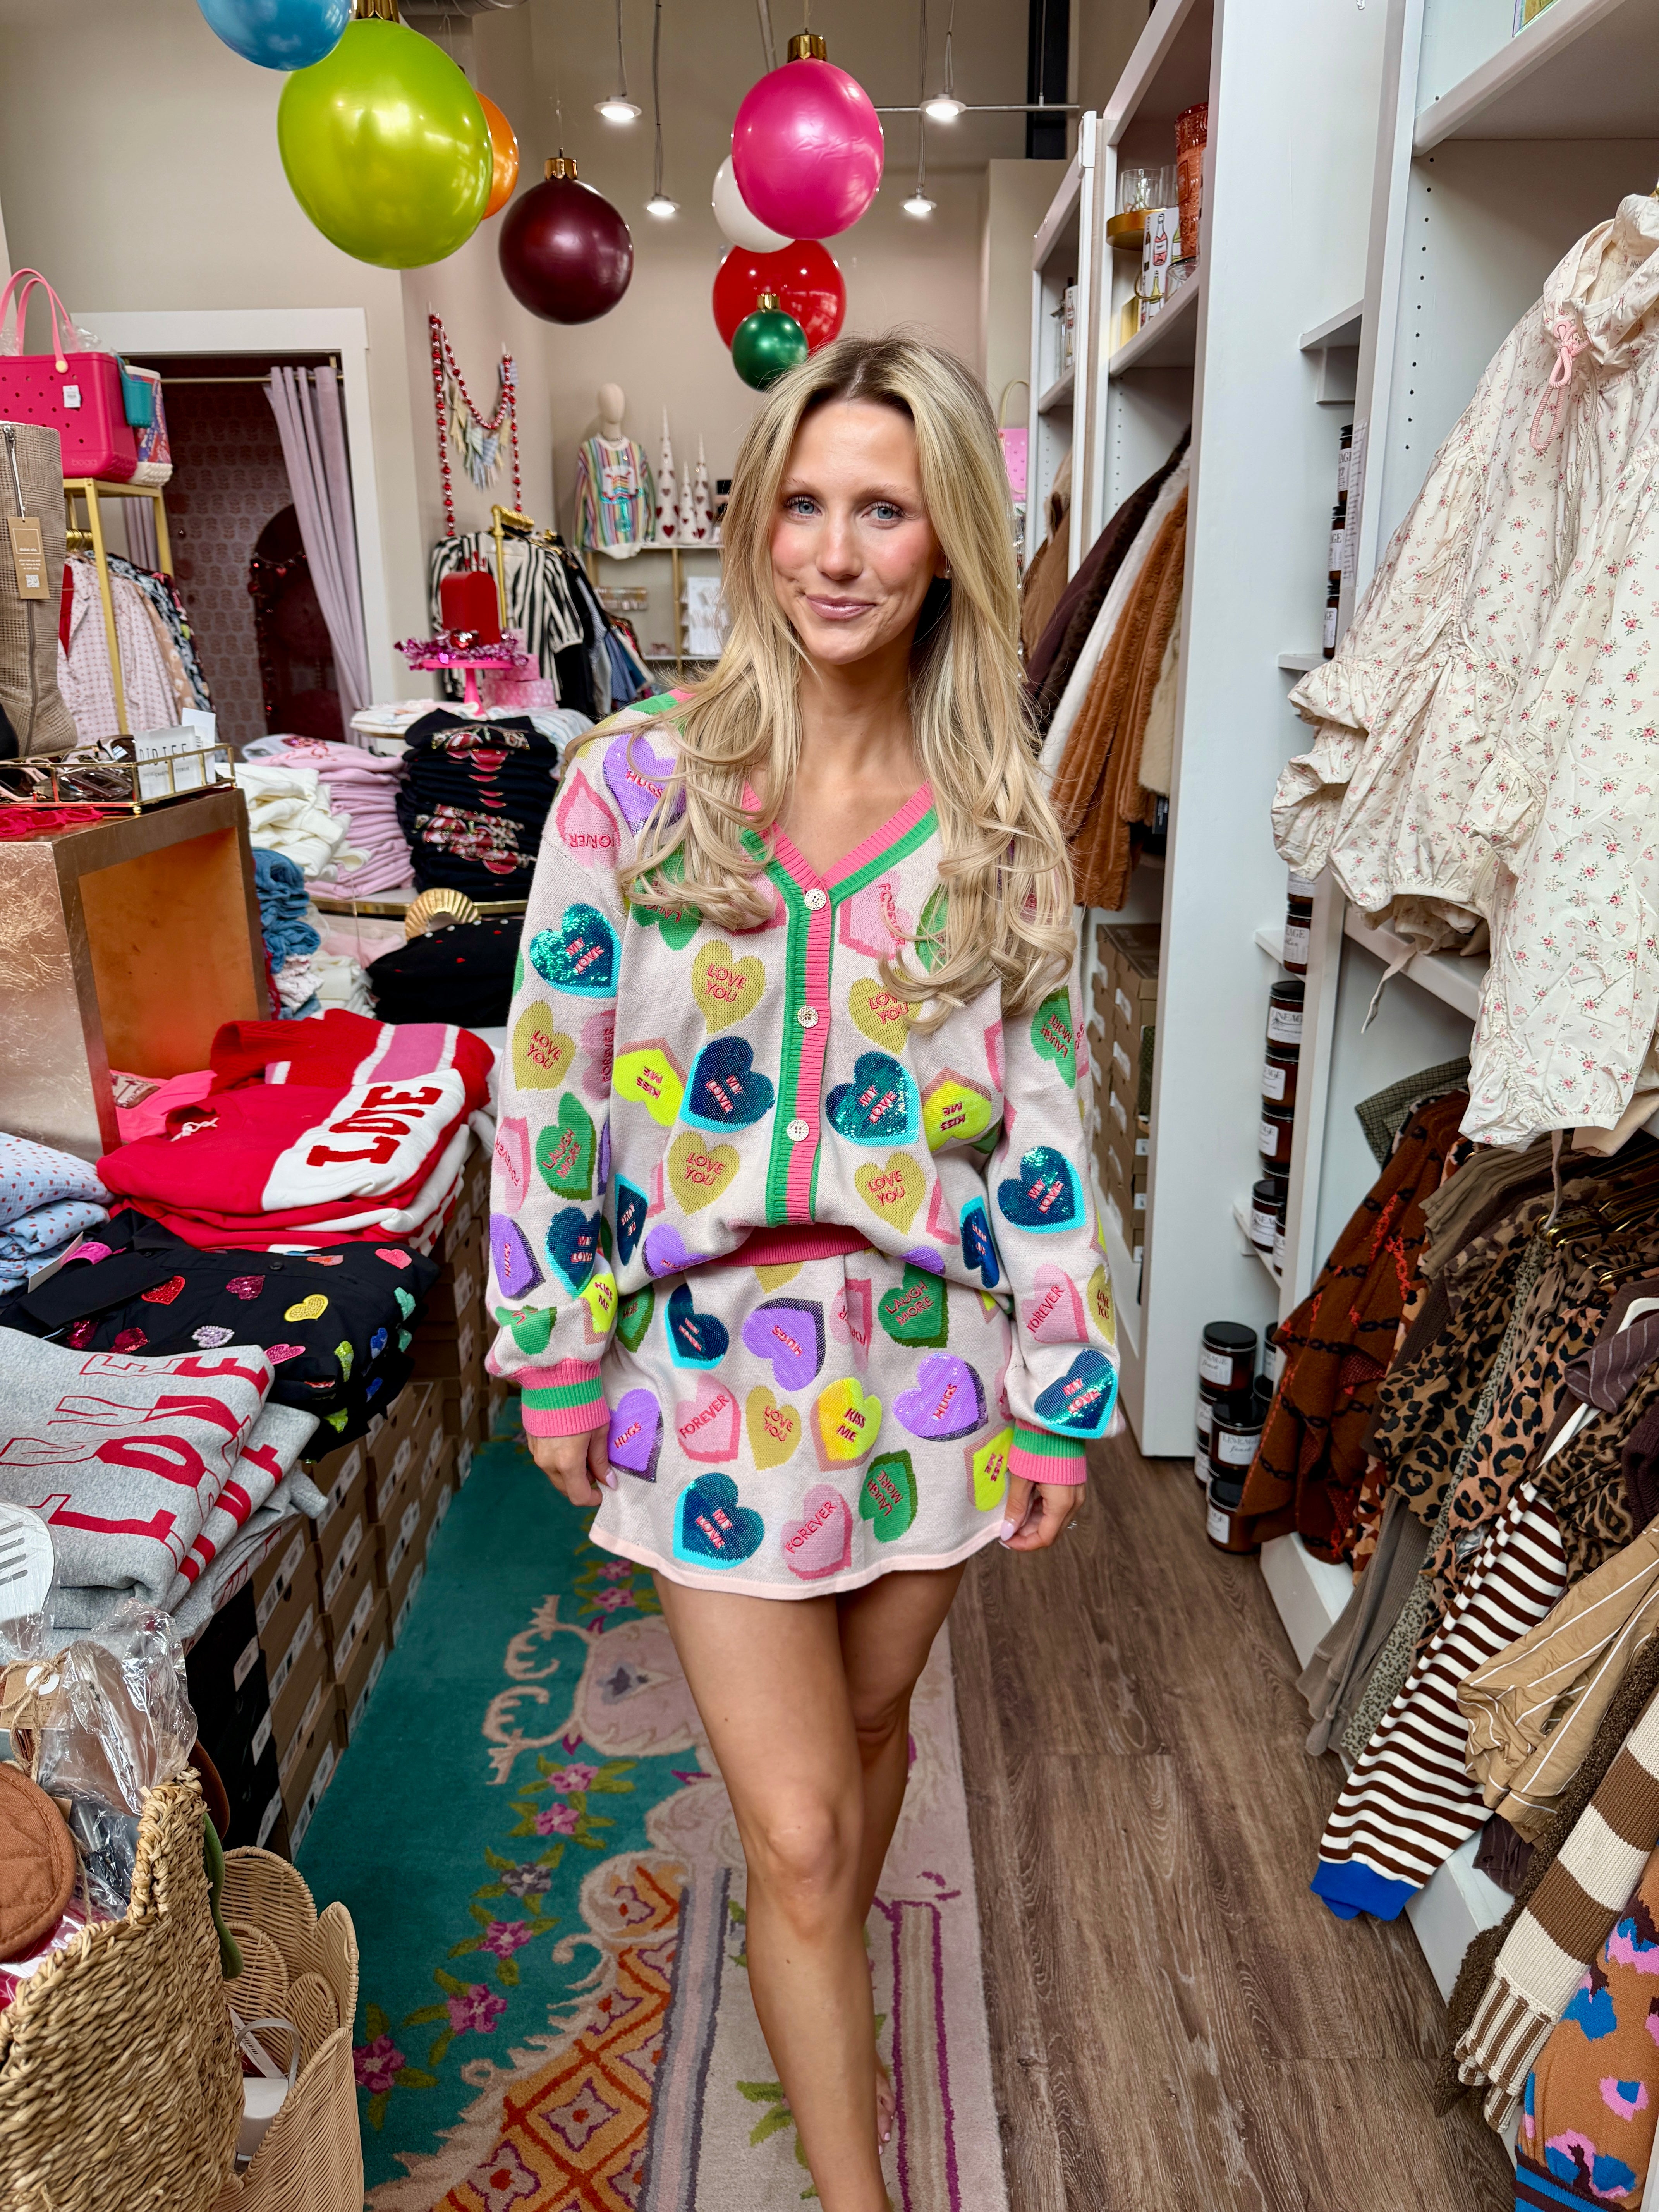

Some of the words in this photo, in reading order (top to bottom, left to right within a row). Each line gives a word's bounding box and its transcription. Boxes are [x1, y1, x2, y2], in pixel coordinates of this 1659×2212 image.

[575, 945, 604, 974] LOVE
[706, 963, 747, 989] LOVE
[707, 982, 737, 1003] YOU
[876, 1001, 908, 1024] YOU
[531, 1029, 563, 1061] LOVE
[602, 1027, 615, 1083] FOREVER
[526, 1045, 554, 1070] YOU
[643, 1066, 663, 1085] ME
[726, 1074, 744, 1095] MY
[636, 1077, 661, 1099] KISS
[705, 1080, 733, 1114] LOVE
[858, 1085, 876, 1108] MY
[868, 1089, 898, 1124] LOVE
[942, 1101, 963, 1115] ME
[940, 1113, 966, 1132] KISS
[541, 1128, 576, 1170] LAUGH
[556, 1142, 582, 1179] MORE
[686, 1151, 725, 1175] LOVE
[684, 1166, 716, 1186] YOU
[867, 1169, 904, 1193] LOVE
[876, 1185, 905, 1207] YOU
[1027, 1178, 1046, 1200] MY
[1038, 1180, 1064, 1214] LOVE
[577, 1236, 592, 1246] MY
[594, 1281, 613, 1302] KISS
[598, 1294, 610, 1311] ME
[884, 1279, 930, 1316] LAUGH
[895, 1295, 935, 1326] MORE
[1025, 1284, 1065, 1334] FOREVER
[1096, 1303, 1110, 1321] YOU
[771, 1324, 804, 1358] HUGS
[1062, 1377, 1083, 1396] MY
[932, 1383, 959, 1422] HUGS
[1066, 1389, 1102, 1414] LOVE
[678, 1393, 731, 1439] FOREVER
[763, 1405, 794, 1433] LOVE
[843, 1407, 867, 1429] KISS
[614, 1421, 642, 1449] HUGS
[764, 1419, 788, 1442] YOU
[836, 1424, 857, 1443] ME
[984, 1452, 997, 1474] ME
[867, 1477, 894, 1517] LAUGH
[876, 1469, 903, 1504] MORE
[712, 1508, 734, 1530] MY
[785, 1500, 838, 1554] FOREVER
[696, 1515, 726, 1550] LOVE
